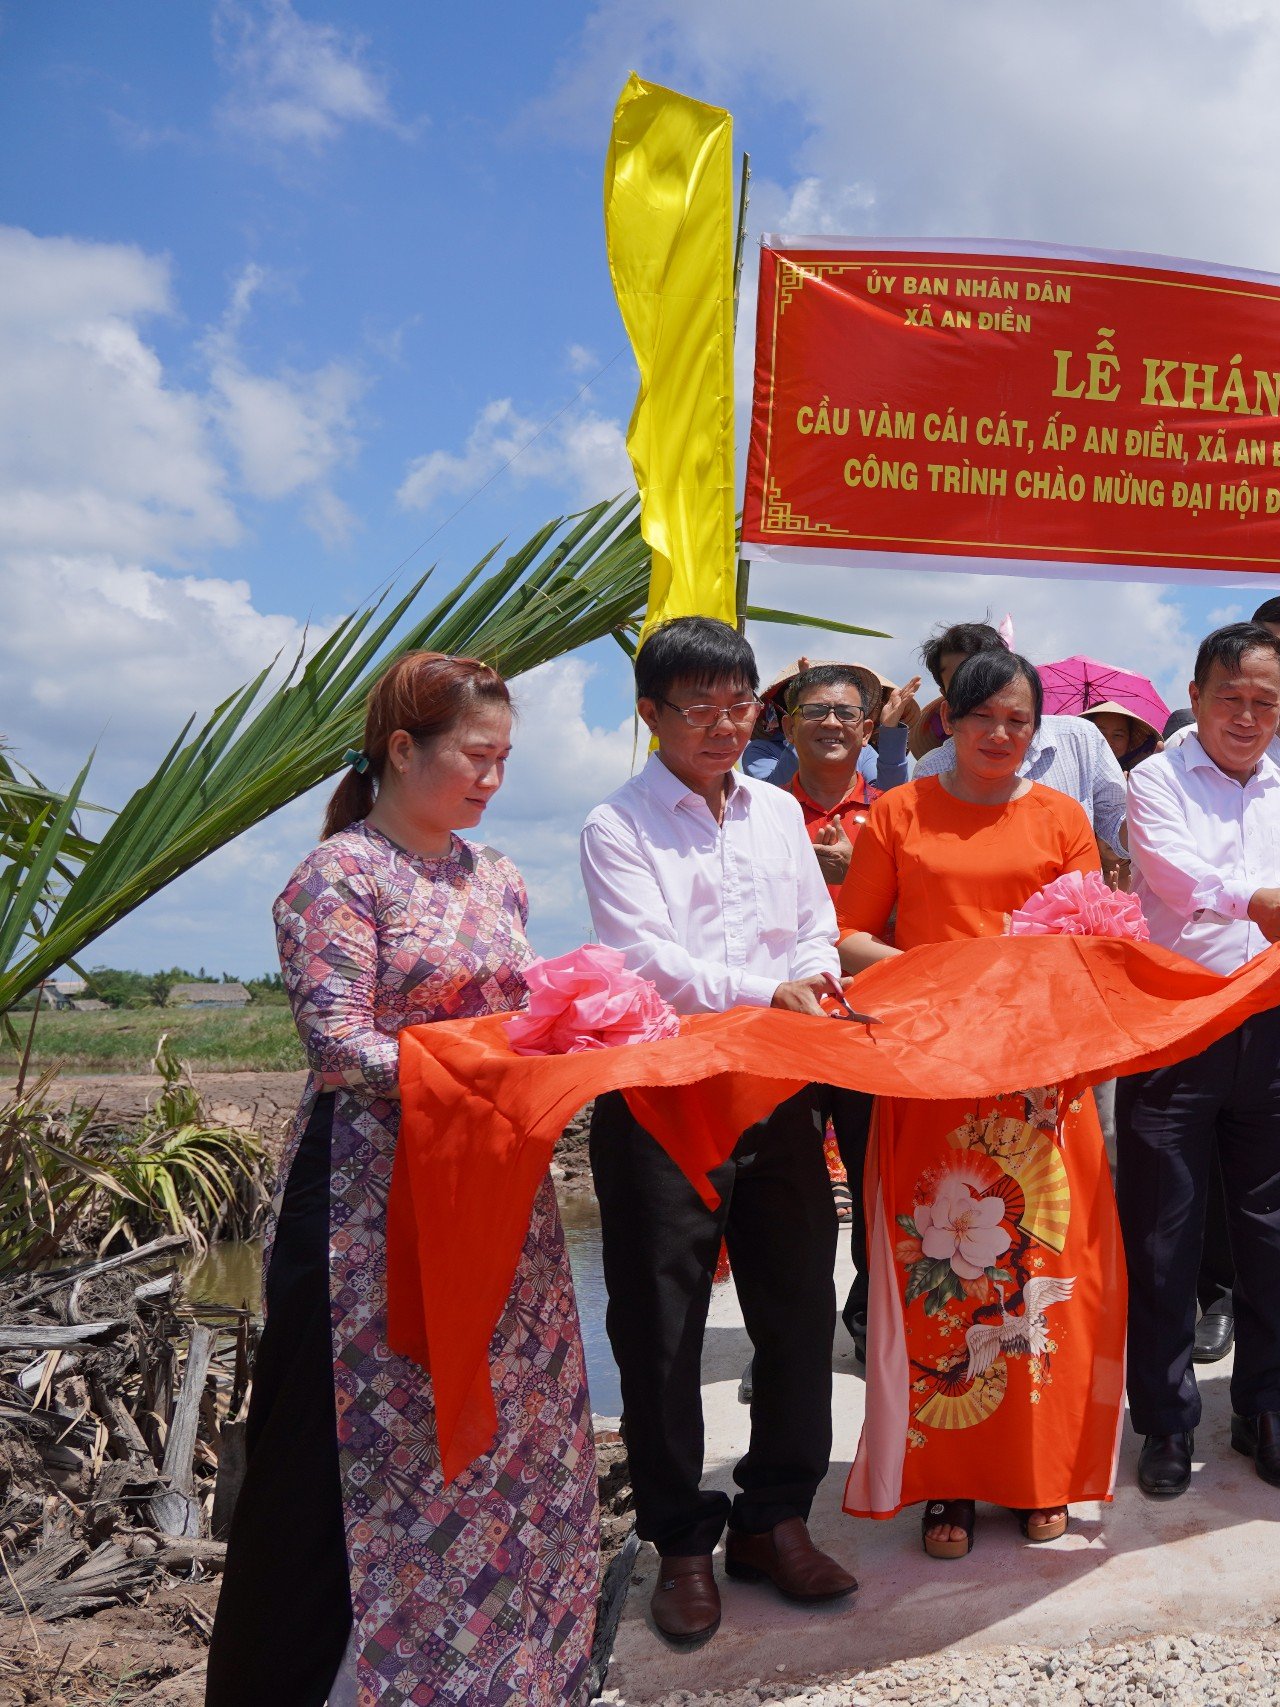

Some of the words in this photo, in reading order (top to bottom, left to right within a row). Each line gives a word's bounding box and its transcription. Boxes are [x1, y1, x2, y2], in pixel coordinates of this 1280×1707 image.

[866, 269, 897, 294] ỦY
[903, 276, 949, 295] BAN
[956, 277, 1019, 299] NHÂN
[1025, 281, 1071, 303] DÂN
[904, 304, 934, 326] XÃ
[940, 310, 972, 328] AN
[978, 306, 1032, 333] ĐIỀN
[1052, 327, 1121, 401] LỄ
[796, 396, 850, 436] CẦU
[859, 402, 916, 439] VÀM
[924, 407, 968, 443] CÁI
[976, 410, 1034, 455] CÁT,
[1042, 411, 1077, 451] ẤP
[1083, 426, 1118, 454] AN
[1125, 420, 1189, 465] ĐIỀN,
[1197, 428, 1227, 462] XÃ
[1235, 438, 1266, 465] AN
[843, 453, 919, 491] CÔNG
[927, 457, 1008, 497] TRÌNH
[1015, 465, 1086, 503] CHÀO
[1092, 469, 1165, 508] MỪNG
[1172, 482, 1212, 520] ĐẠI
[1219, 480, 1259, 520] HỘI
